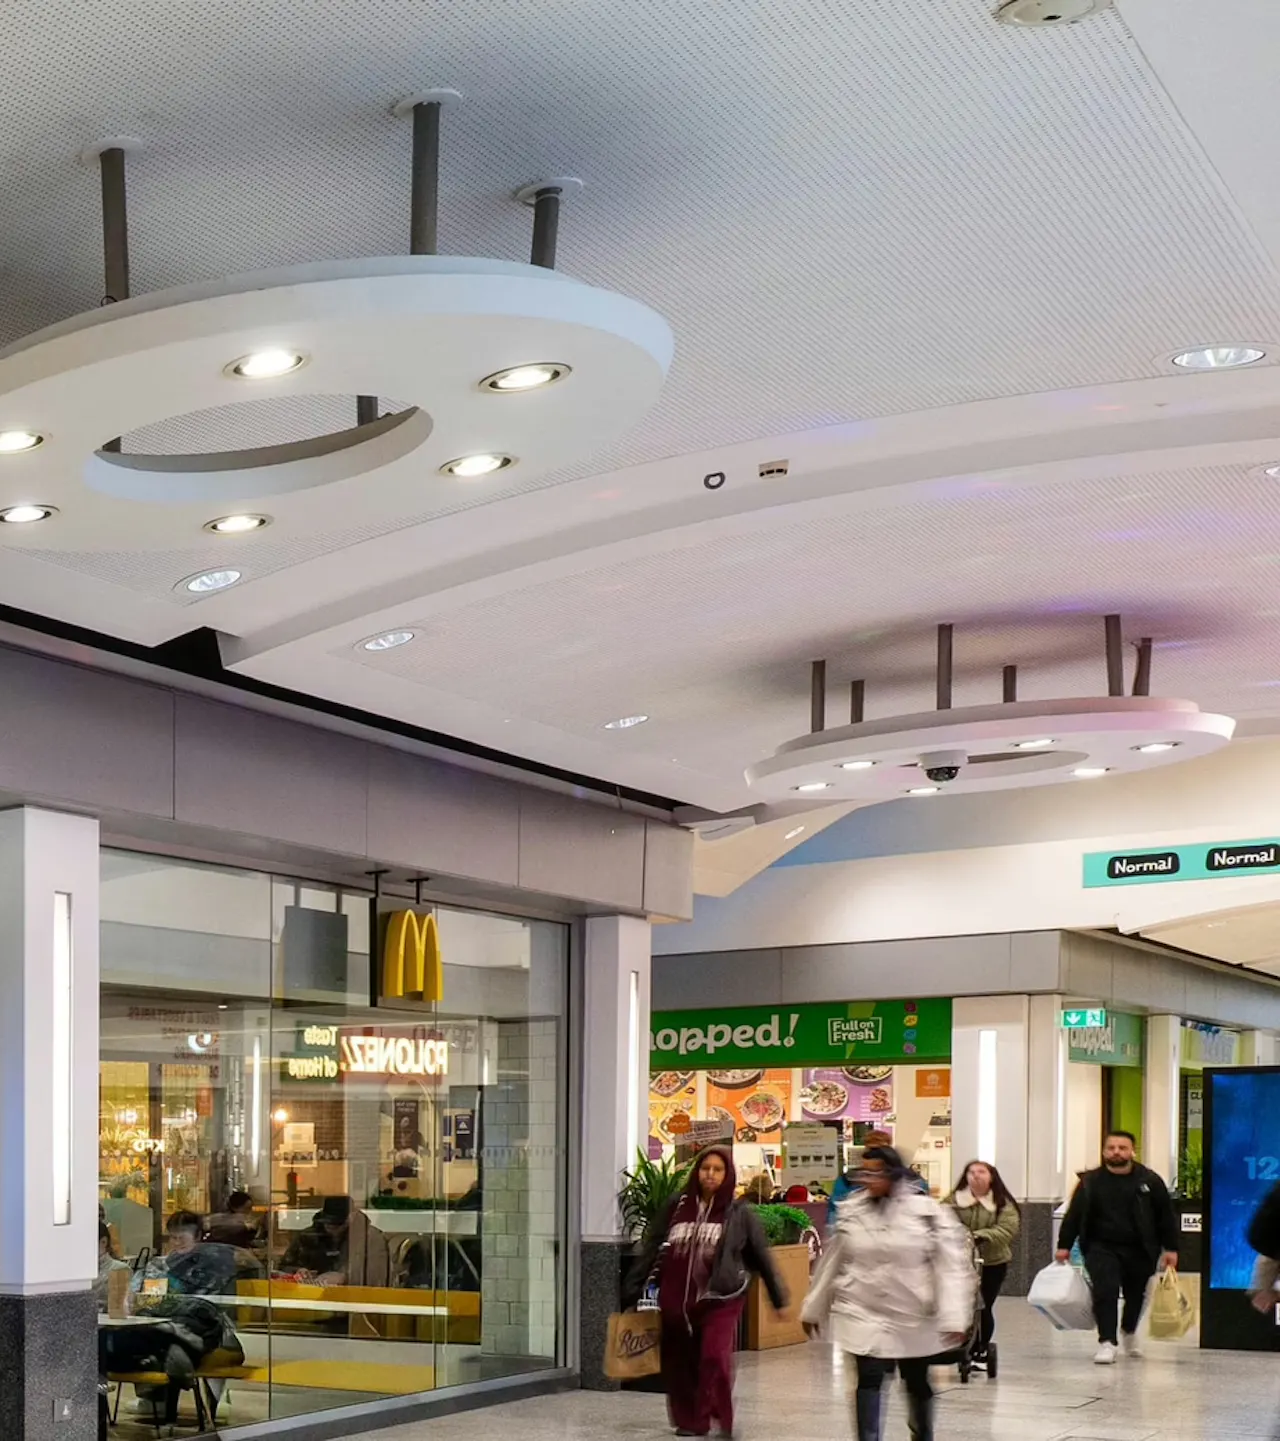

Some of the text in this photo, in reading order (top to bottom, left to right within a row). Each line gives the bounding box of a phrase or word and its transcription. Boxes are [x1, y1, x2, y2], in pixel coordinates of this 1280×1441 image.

[1114, 856, 1172, 874] Normal
[1213, 848, 1275, 867] Normal
[650, 1014, 800, 1055] opped!
[833, 1020, 875, 1033] Full on
[832, 1030, 876, 1043] Fresh
